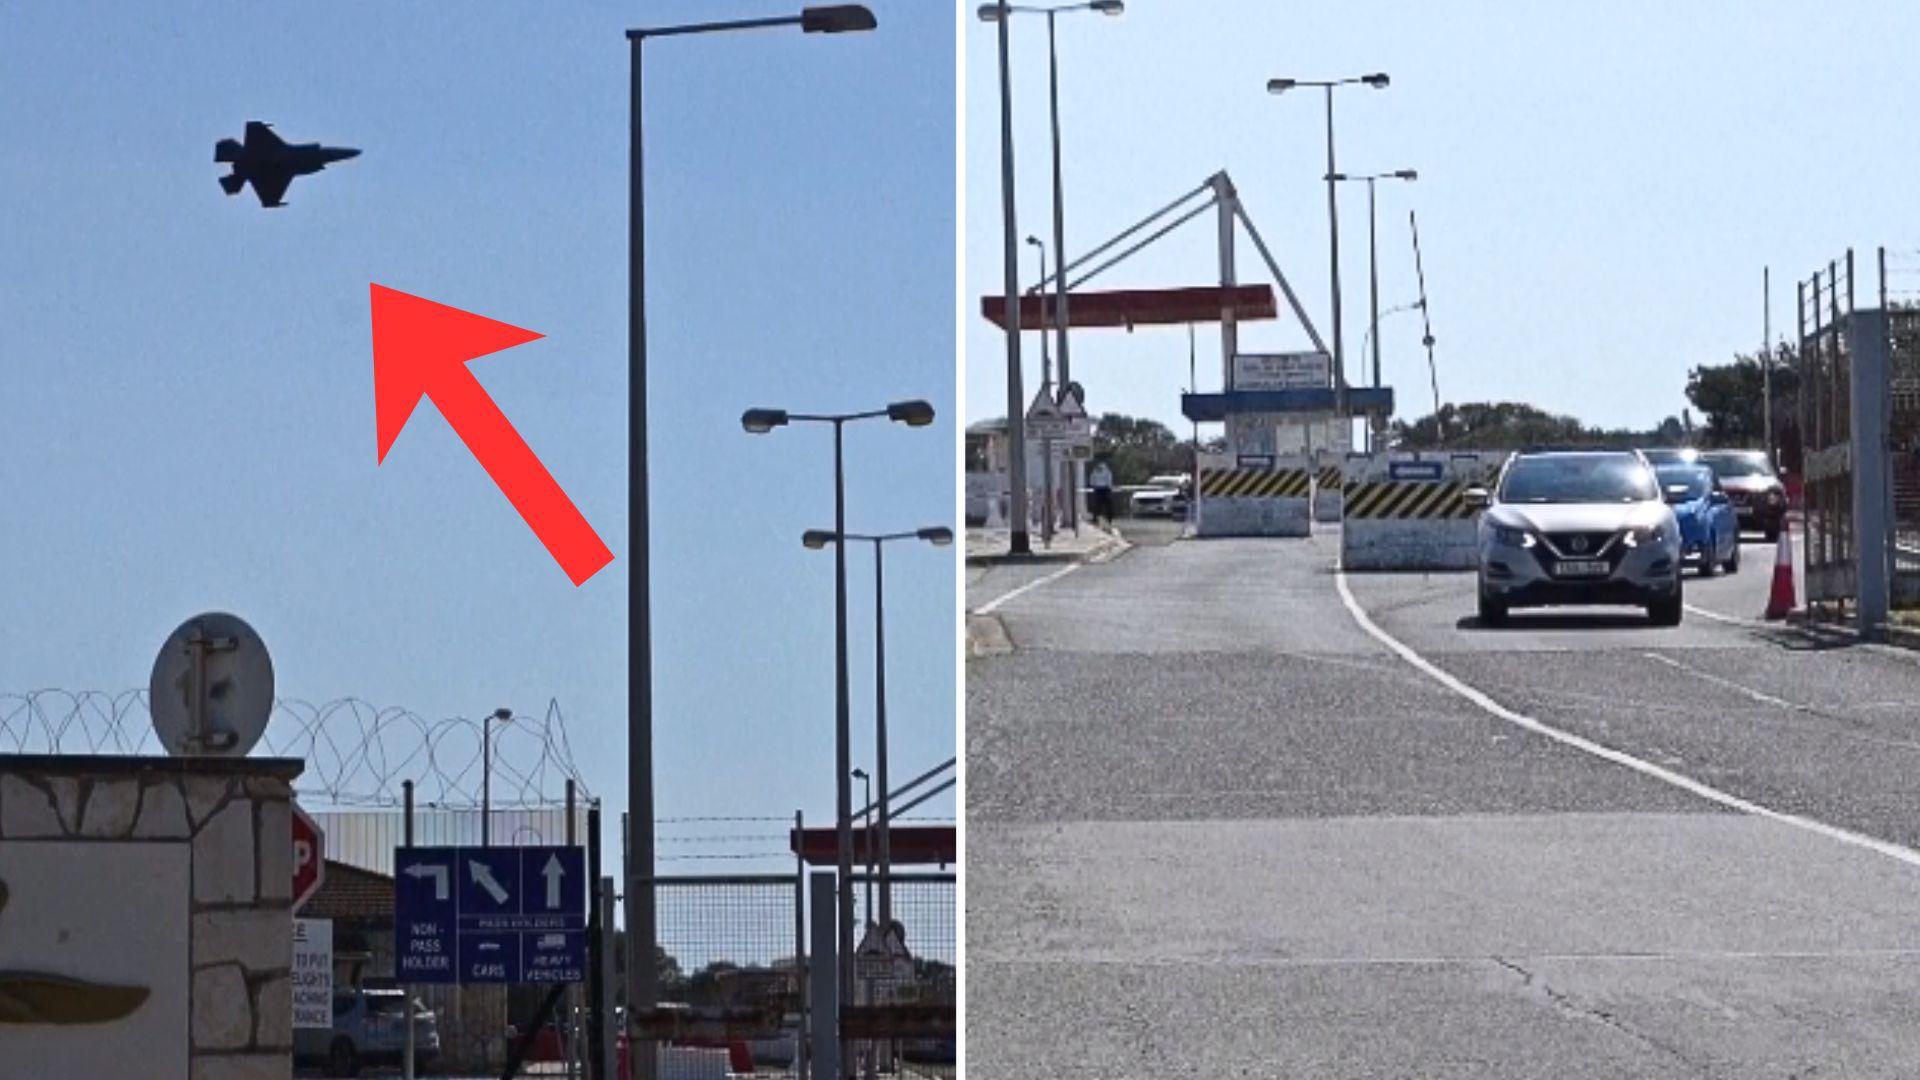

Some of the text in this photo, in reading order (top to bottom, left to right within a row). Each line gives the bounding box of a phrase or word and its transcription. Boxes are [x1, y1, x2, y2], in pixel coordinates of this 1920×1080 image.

[411, 939, 441, 952] PASS
[309, 952, 328, 968] PUT
[403, 956, 449, 970] HOLDER
[533, 956, 572, 965] HEAVY
[472, 963, 505, 977] CARS
[527, 968, 581, 980] VEHICLES
